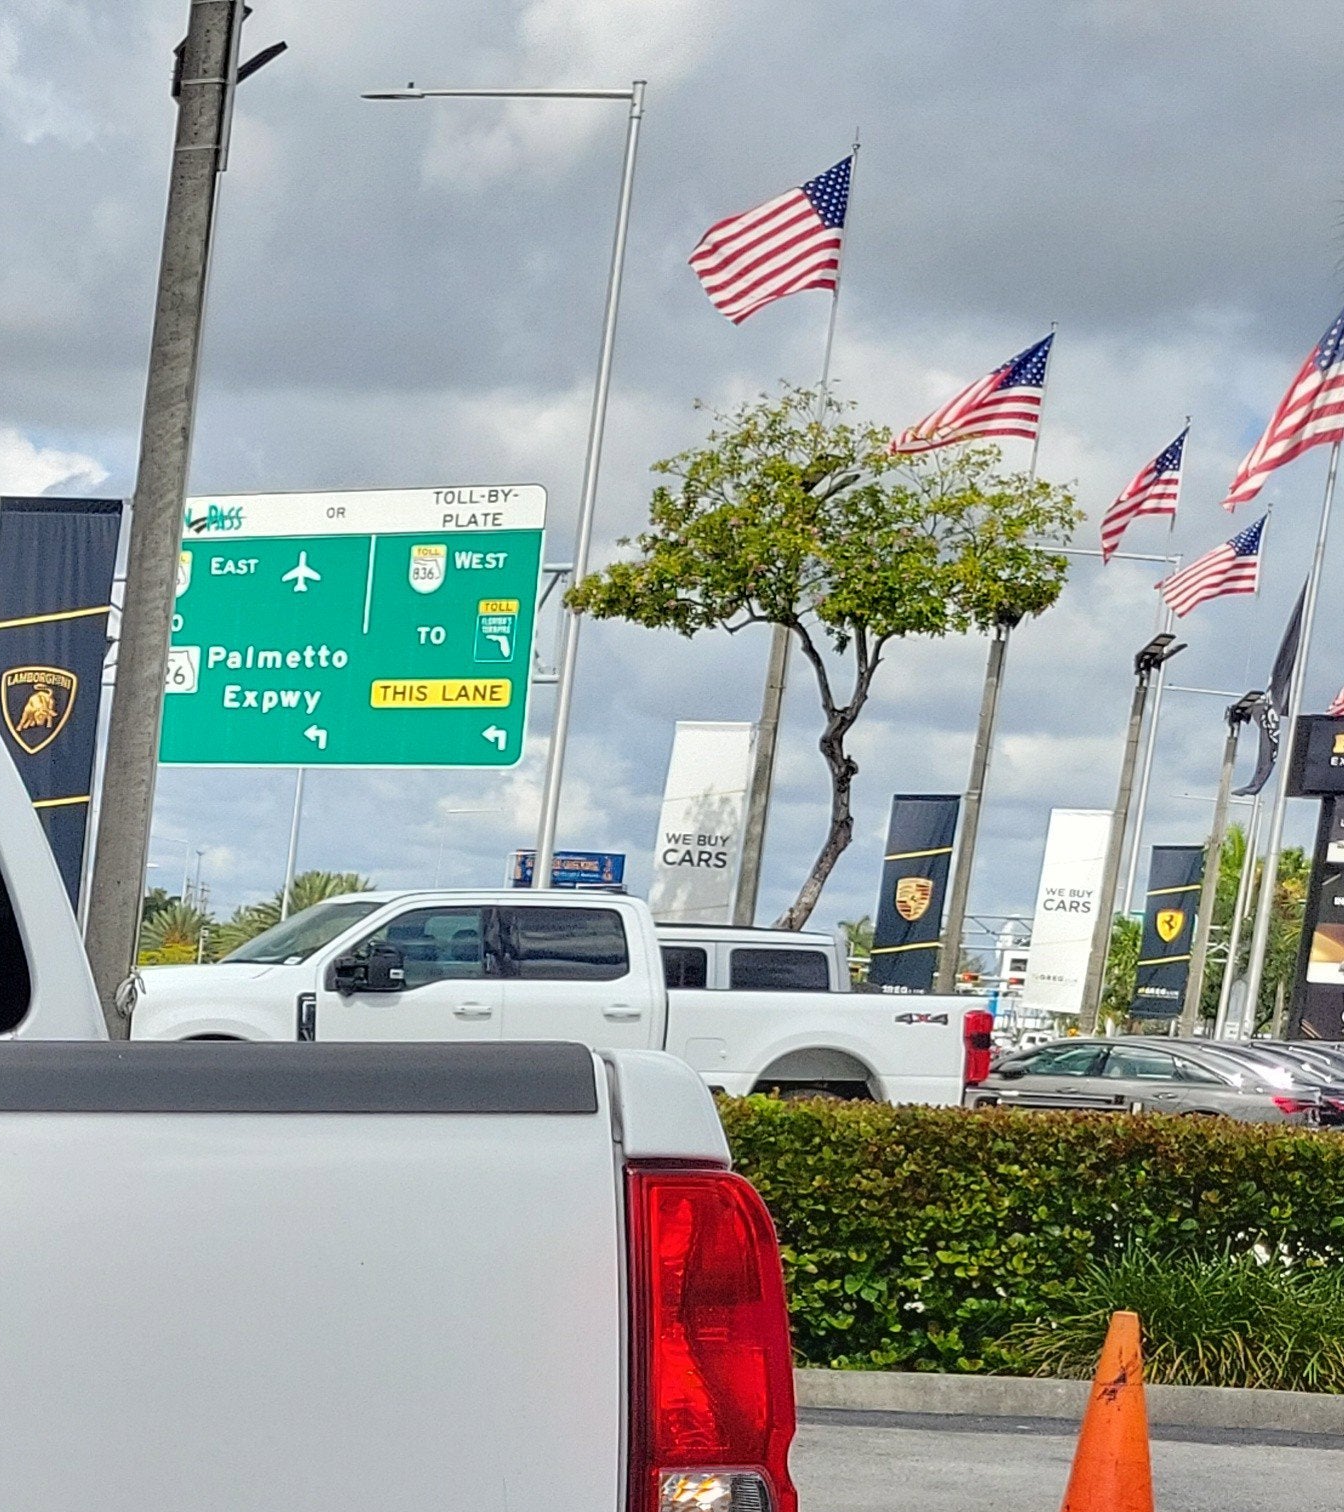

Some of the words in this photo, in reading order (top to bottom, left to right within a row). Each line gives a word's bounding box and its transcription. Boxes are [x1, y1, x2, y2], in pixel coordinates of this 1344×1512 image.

[433, 489, 519, 505] TOLL-BY-
[326, 507, 346, 519] OR
[442, 513, 503, 528] PLATE
[417, 548, 440, 557] TOLL
[454, 550, 508, 570] WEST
[211, 556, 259, 575] EAST
[412, 567, 434, 580] 836
[484, 602, 513, 612] TOLL
[417, 626, 446, 645] TO
[207, 644, 348, 669] Palmetto
[7, 672, 71, 690] LAMBORGHINI
[223, 684, 321, 714] Expwy
[380, 685, 428, 702] THIS
[442, 685, 503, 701] LANE
[665, 833, 692, 845] WE
[697, 835, 730, 847] BUY
[662, 848, 728, 868] CARS
[1045, 888, 1065, 897] WE
[1069, 889, 1093, 898] BUY
[1043, 899, 1091, 913] CARS
